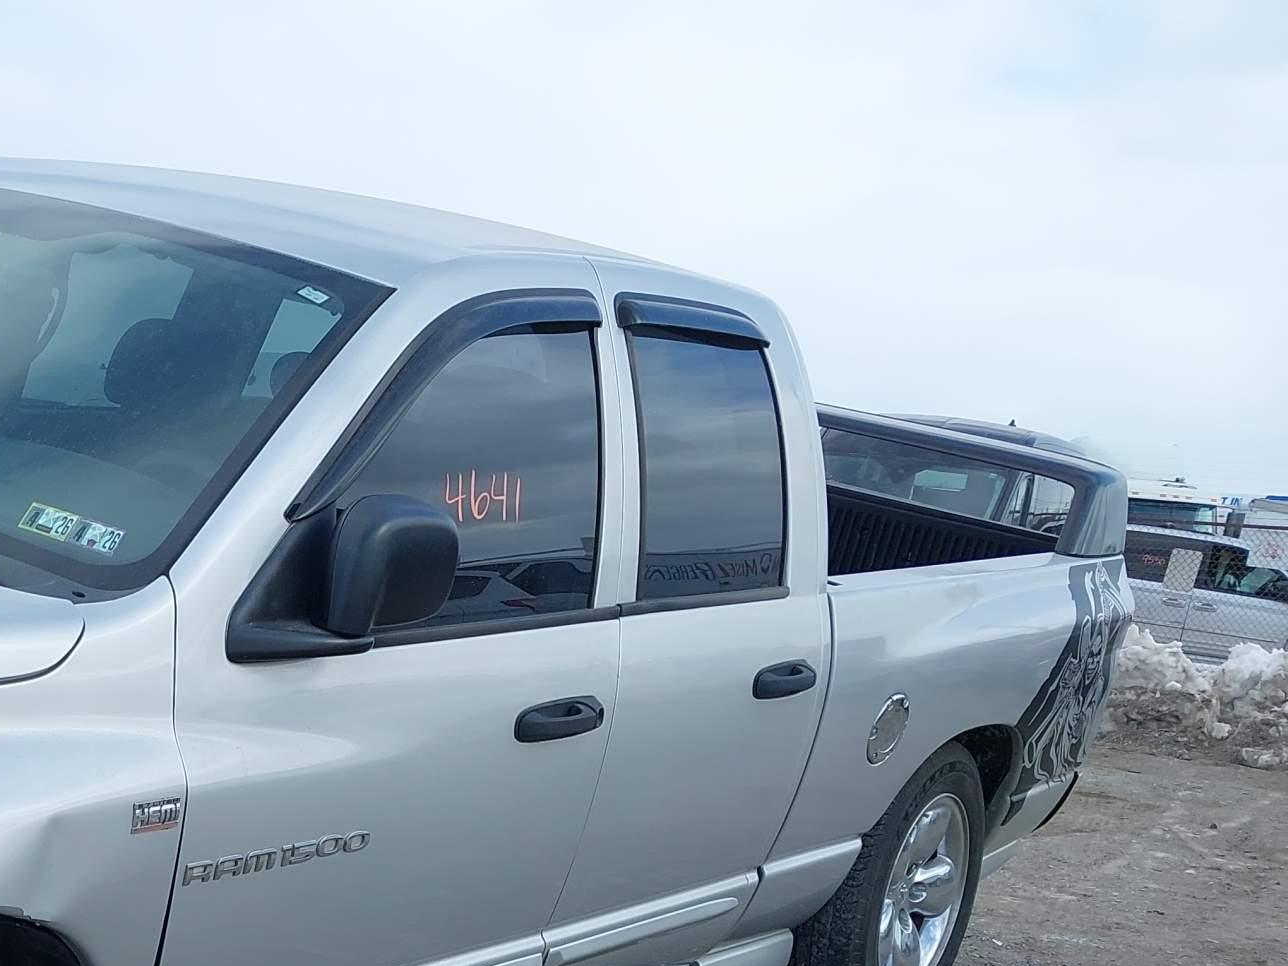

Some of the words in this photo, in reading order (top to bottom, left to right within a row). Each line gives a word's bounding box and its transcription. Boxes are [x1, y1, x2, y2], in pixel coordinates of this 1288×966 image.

[444, 469, 522, 523] 4641
[54, 516, 74, 535] 26
[102, 531, 121, 550] 26
[182, 847, 276, 887] RAM
[279, 830, 371, 868] 1500
